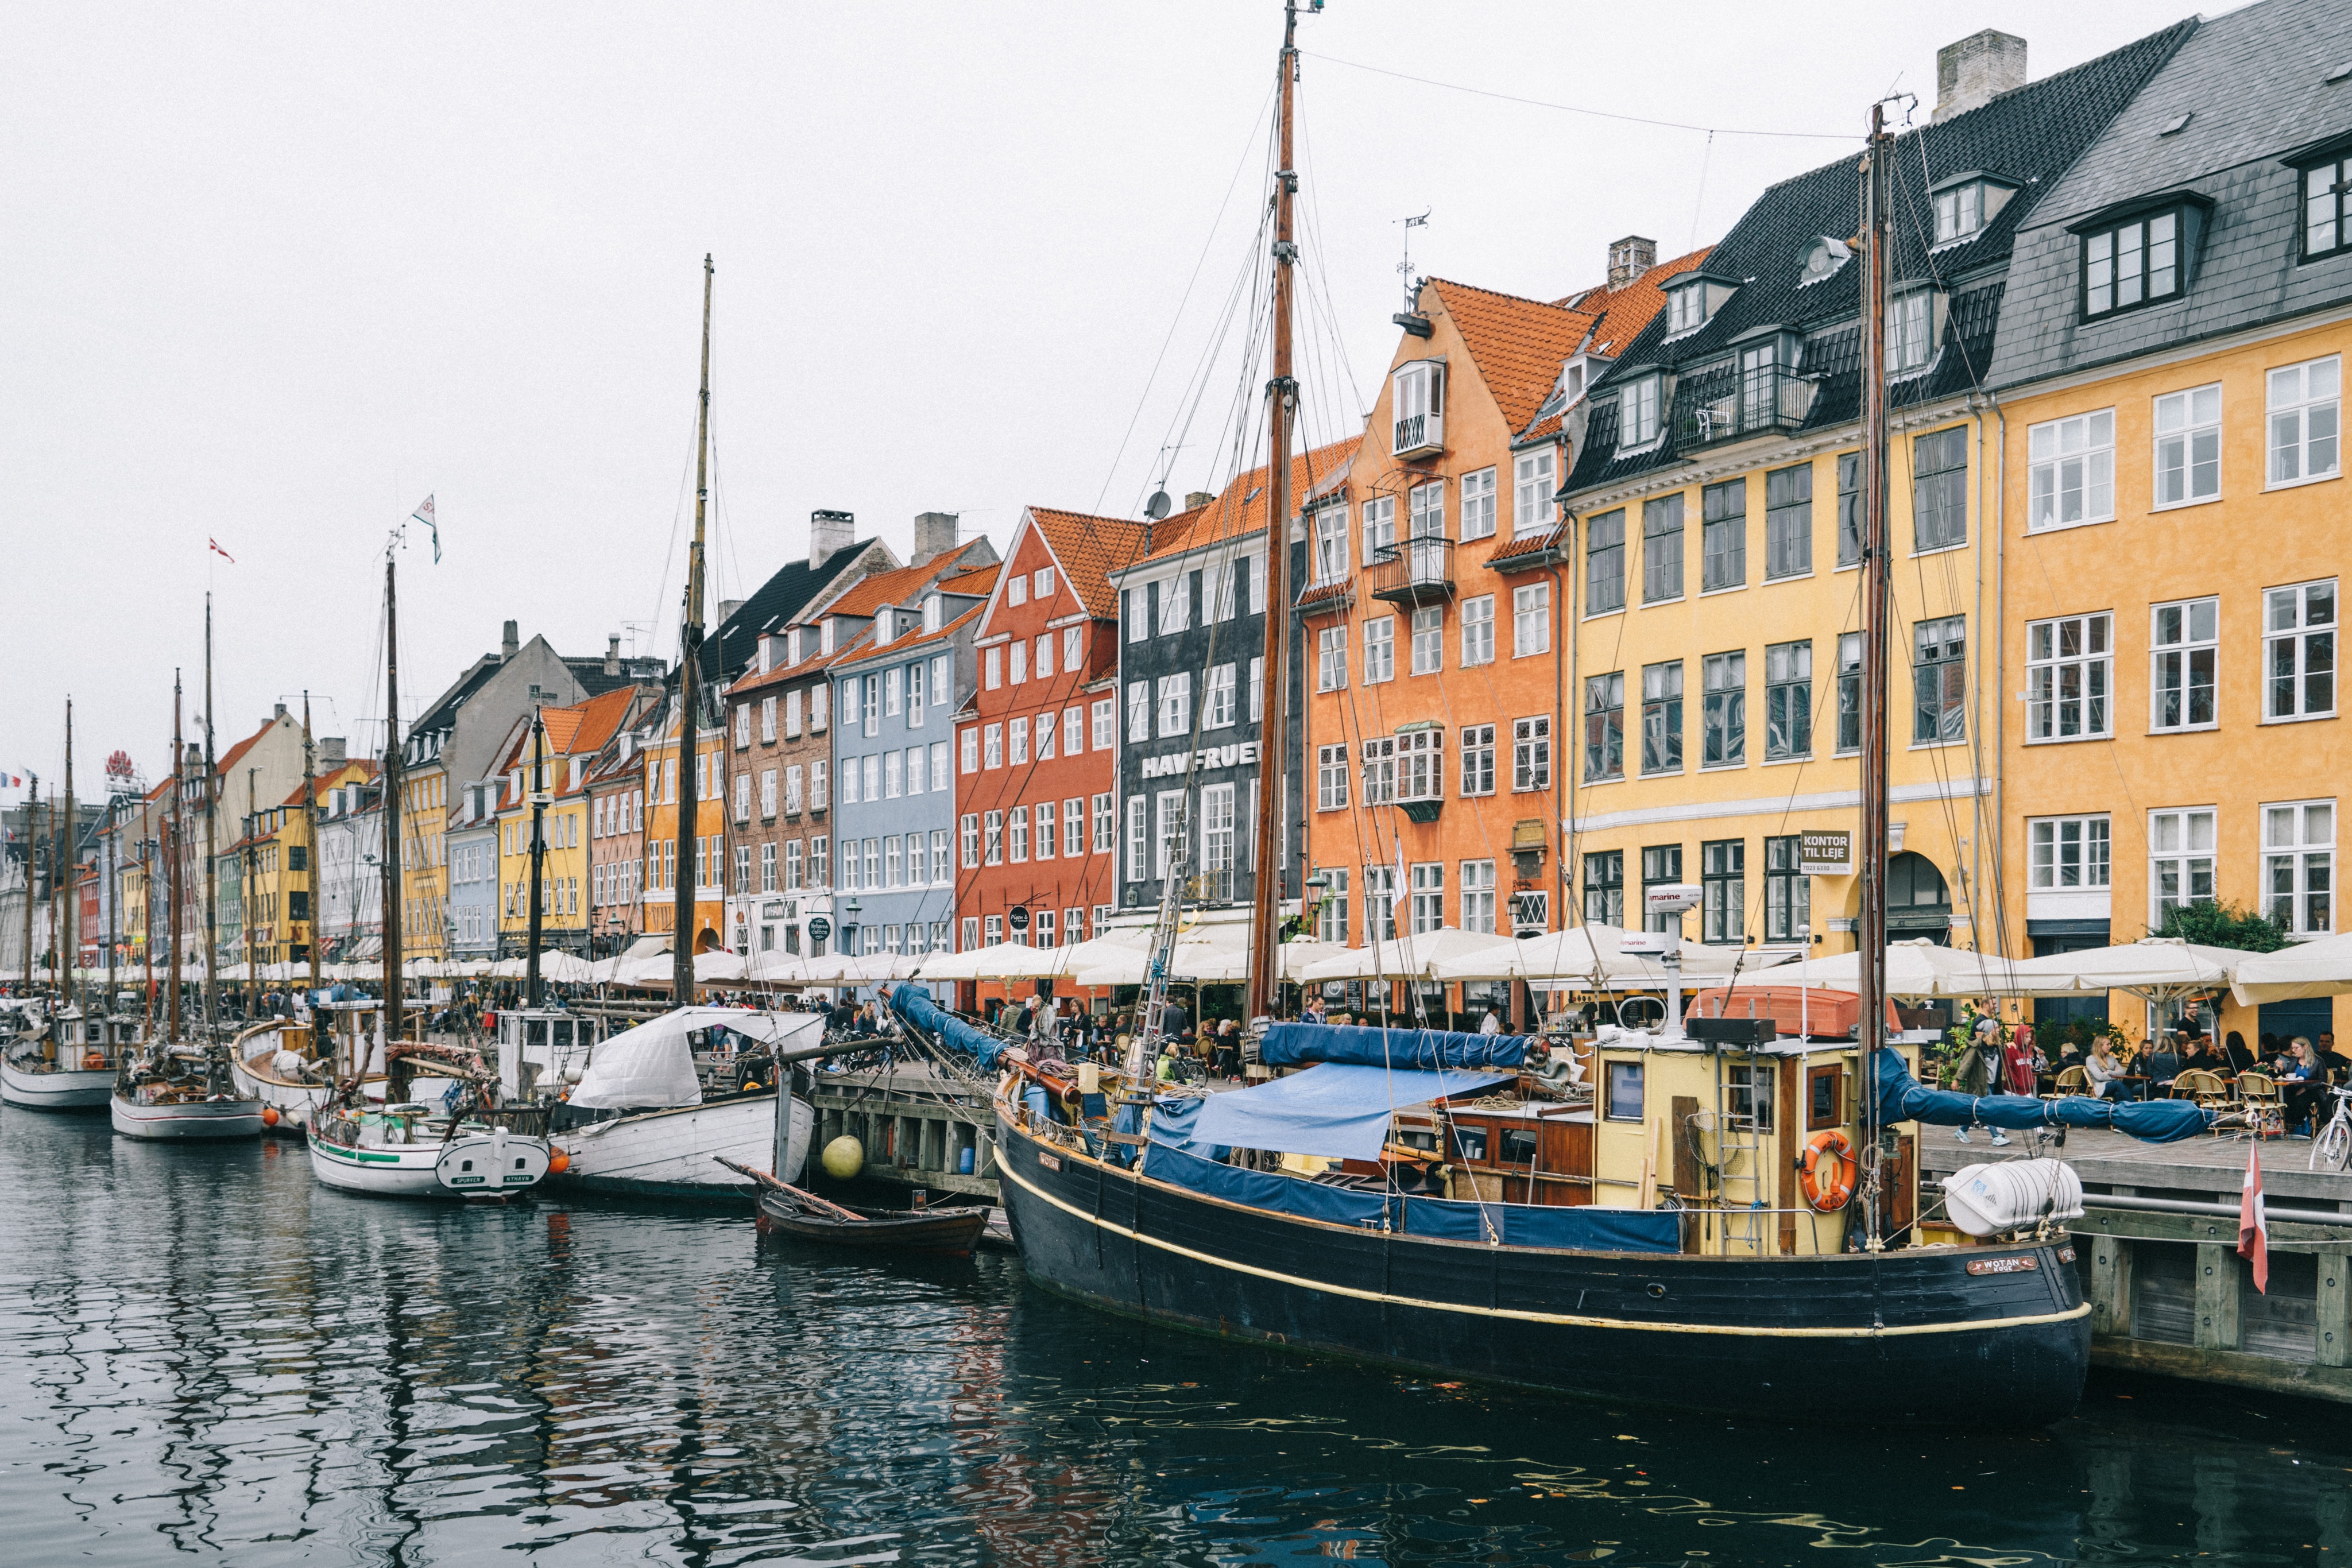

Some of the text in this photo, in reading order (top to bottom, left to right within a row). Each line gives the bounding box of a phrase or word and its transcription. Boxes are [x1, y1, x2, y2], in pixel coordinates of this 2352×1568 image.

[1804, 835, 1847, 846] KONTOR
[1804, 847, 1844, 860] TIL LEJE
[764, 905, 783, 917] NYHAVN
[1040, 1154, 1059, 1170] WOTAN
[1984, 1259, 2020, 1268] WOTAN
